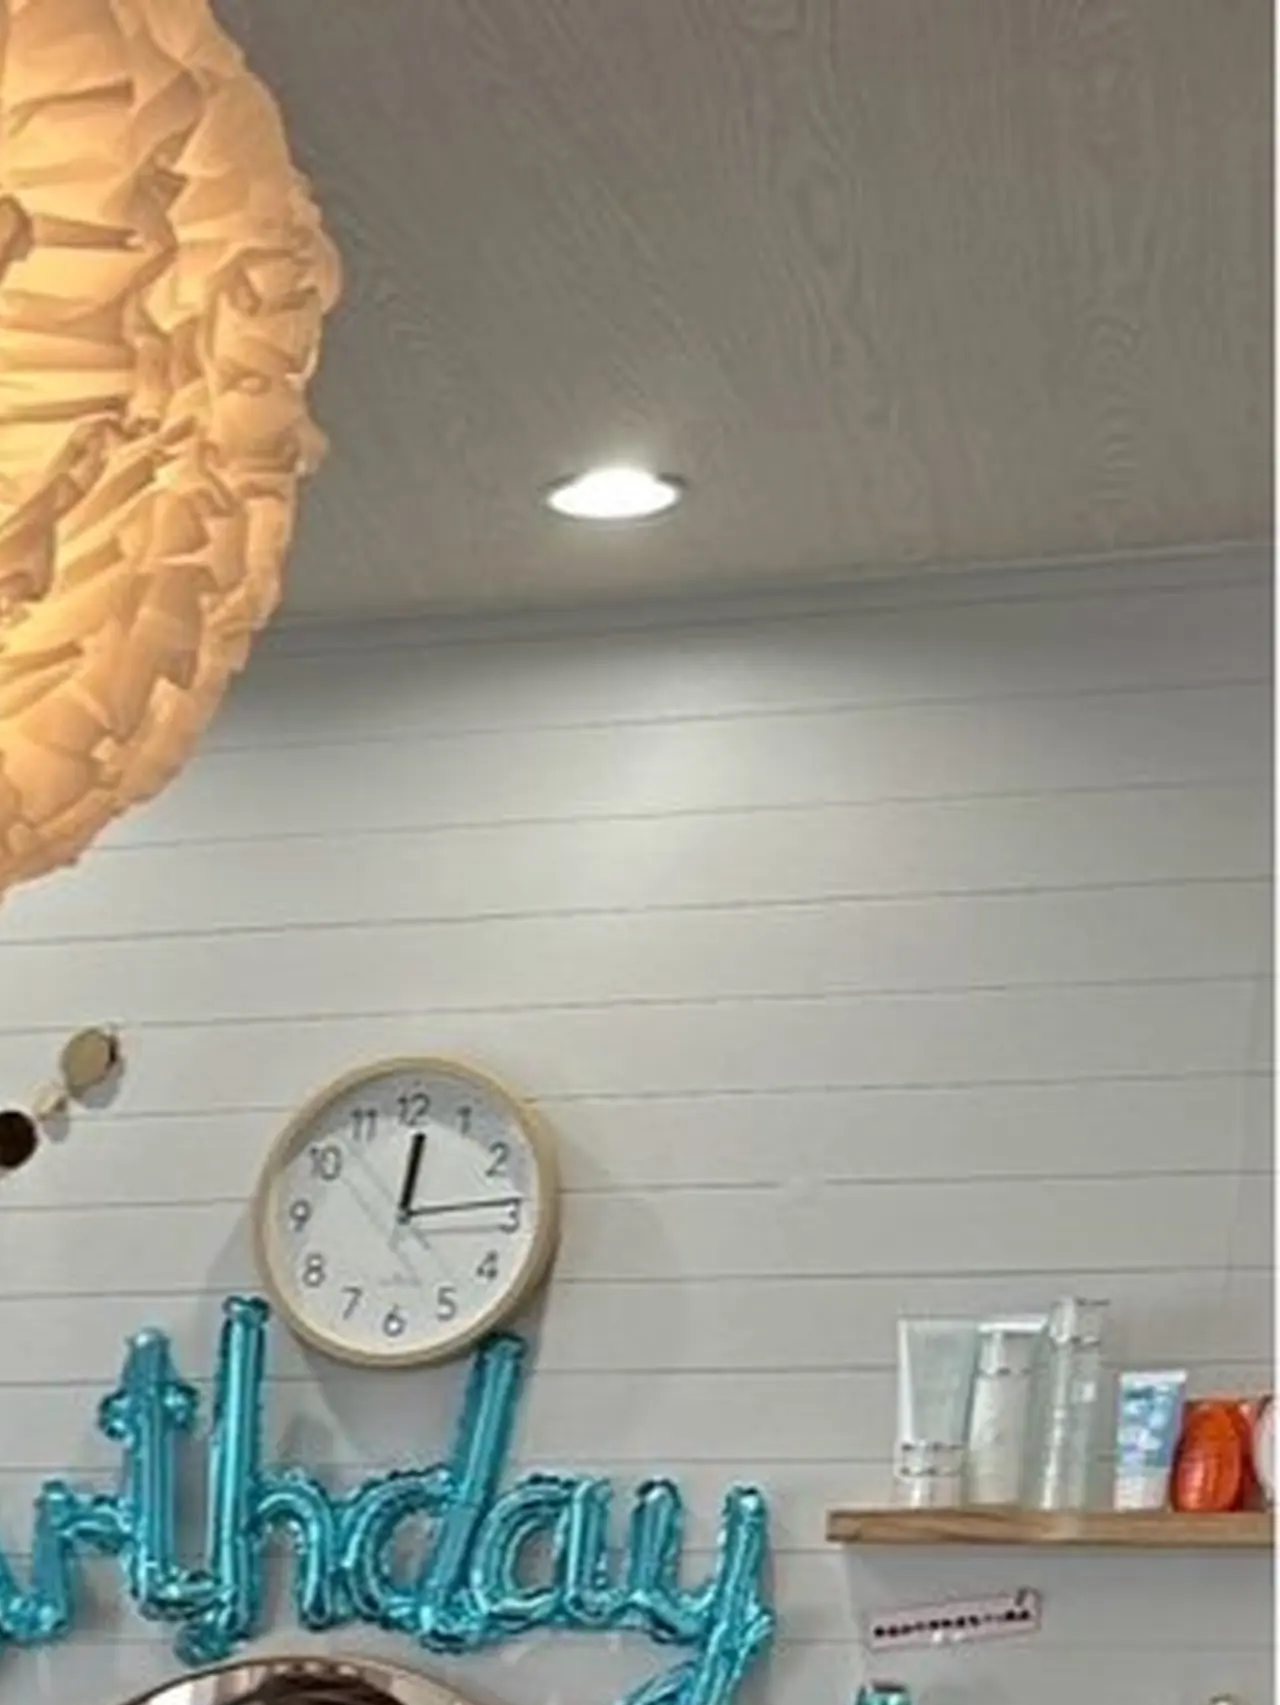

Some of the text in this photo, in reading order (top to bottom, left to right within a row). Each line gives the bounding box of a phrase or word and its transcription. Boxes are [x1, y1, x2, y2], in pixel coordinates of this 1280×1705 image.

[349, 1107, 378, 1142] 11
[397, 1092, 432, 1128] 12
[456, 1105, 473, 1134] 1
[308, 1145, 343, 1181] 10
[485, 1141, 510, 1178] 2
[289, 1199, 311, 1233] 9
[498, 1200, 521, 1234] 3
[302, 1252, 327, 1288] 8
[475, 1251, 499, 1280] 4
[342, 1286, 363, 1320] 7
[436, 1286, 457, 1321] 5
[383, 1304, 406, 1338] 6
